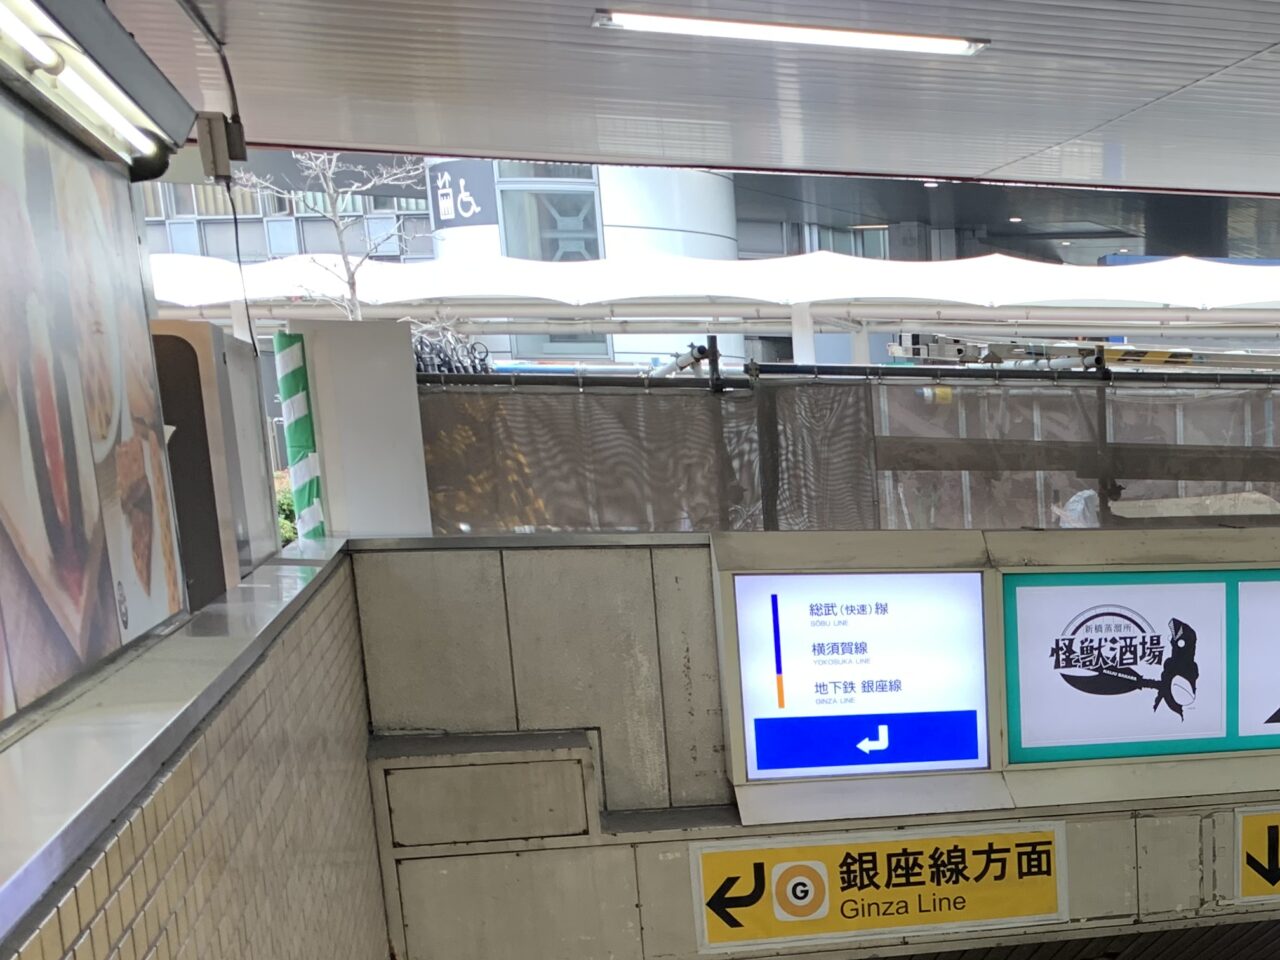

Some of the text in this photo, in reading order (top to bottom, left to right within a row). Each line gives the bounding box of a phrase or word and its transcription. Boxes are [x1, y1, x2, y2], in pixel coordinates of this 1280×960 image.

[811, 641, 868, 656] 横須賀線
[1049, 634, 1165, 670] 怪獣酒場
[855, 657, 871, 665] LINE
[814, 679, 902, 695] 地下鉄 銀座線
[791, 840, 1053, 901] G 銀座線方面
[840, 892, 967, 919] Ginza Line
